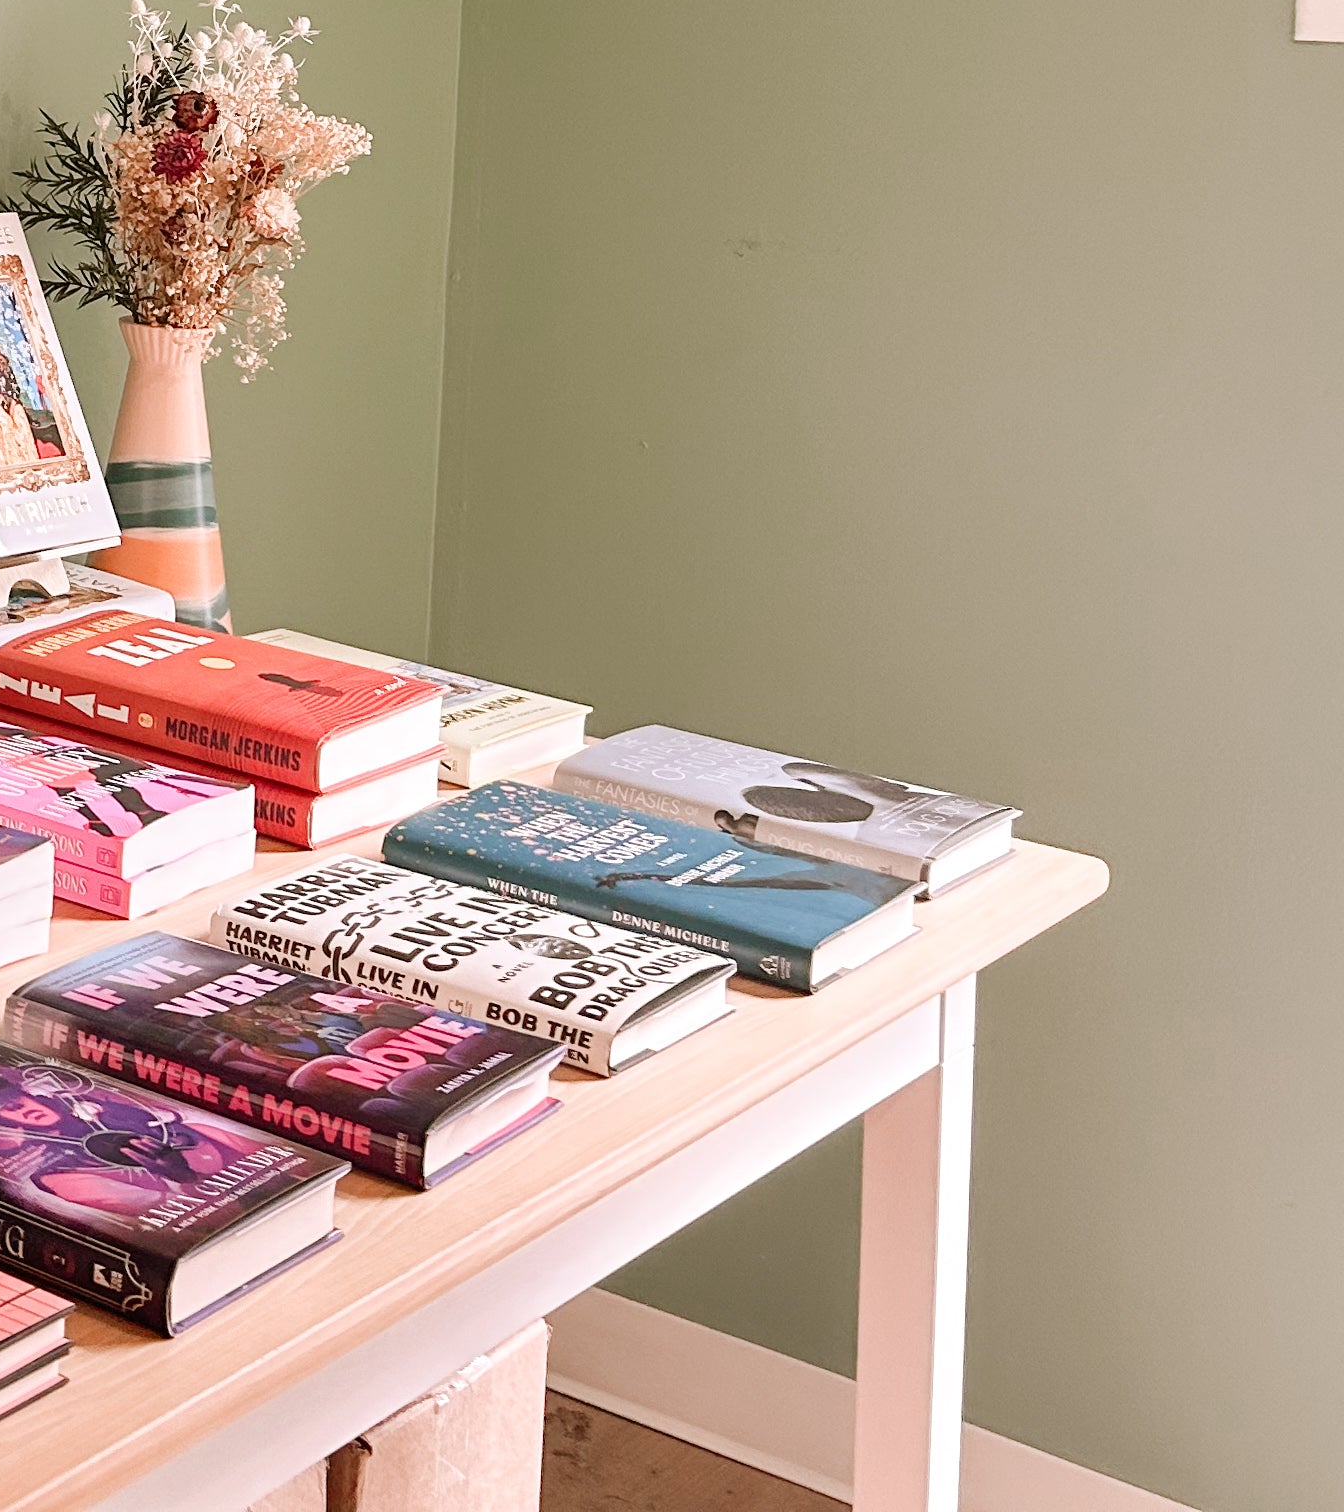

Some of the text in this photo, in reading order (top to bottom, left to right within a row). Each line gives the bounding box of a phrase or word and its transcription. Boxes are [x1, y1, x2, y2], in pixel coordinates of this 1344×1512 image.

[87, 627, 216, 669] ZEAL
[164, 716, 231, 756] MORGAN
[232, 730, 302, 773] JERKINS
[595, 780, 681, 816] FANTASIES
[552, 818, 648, 863] HARVEST
[594, 832, 669, 865] COMES
[234, 854, 381, 920] HARRIET
[271, 867, 412, 929] TUBMAN
[487, 877, 559, 906] WHEN THE
[225, 920, 316, 963] HARRIET
[611, 910, 731, 953] DENNE MICHELE
[356, 961, 439, 1002] LIVE IN
[485, 1001, 592, 1050] BOB THE
[41, 1018, 372, 1156] IF WE WERE A MOVIE
